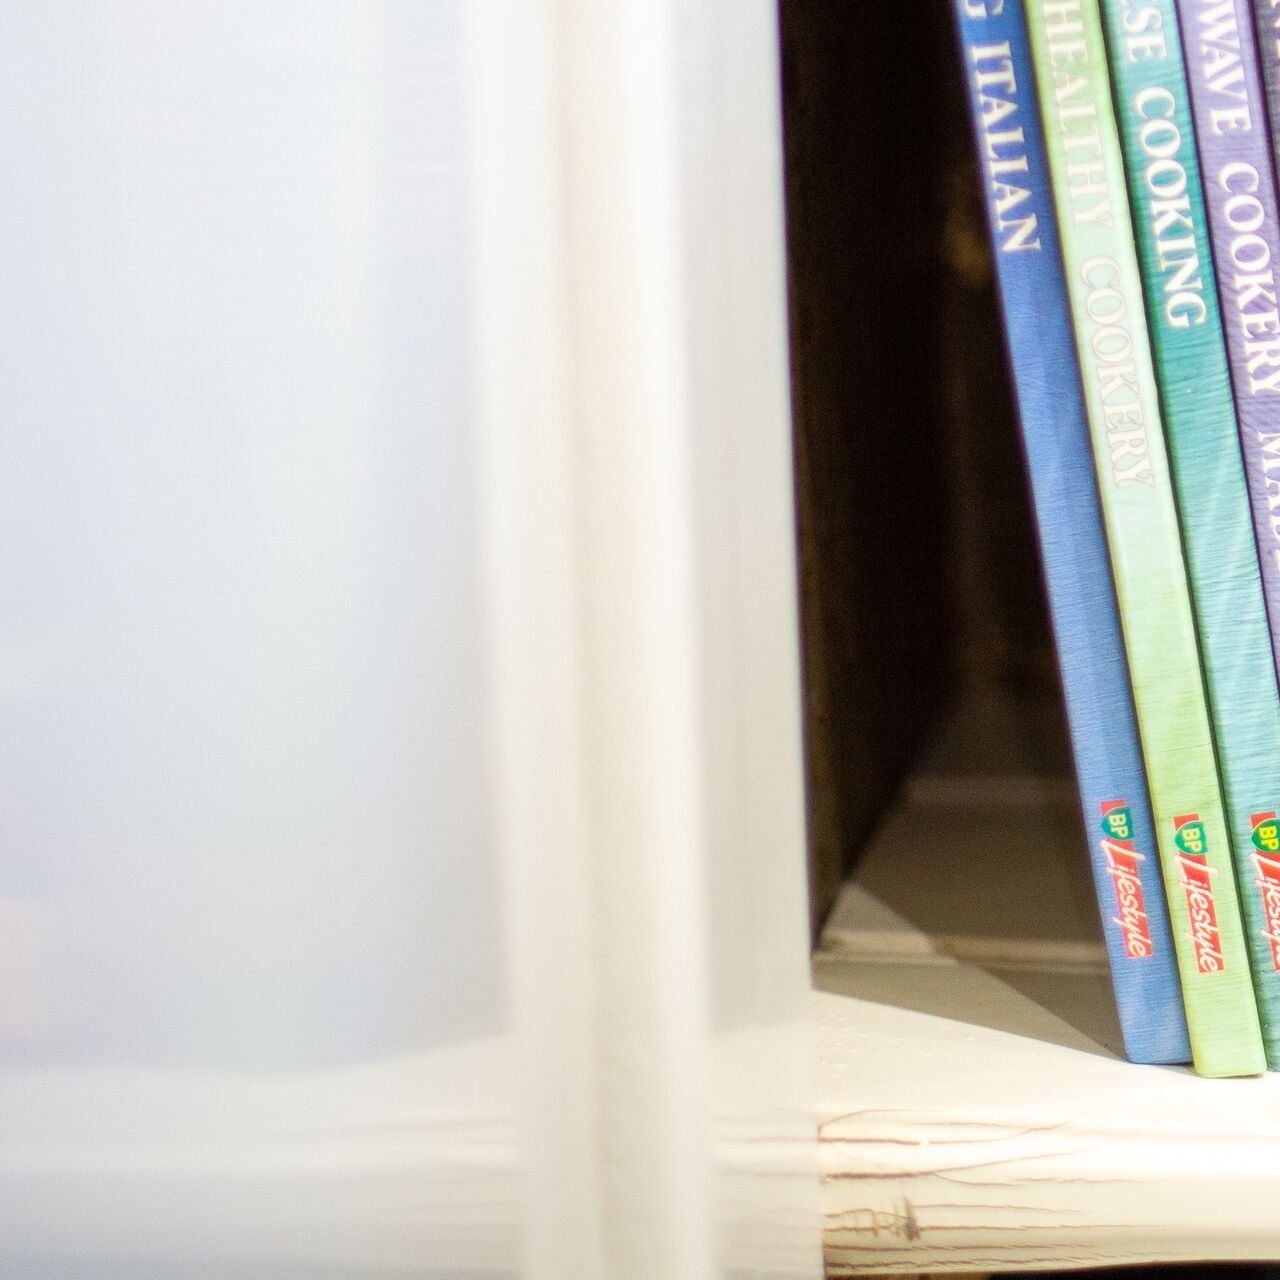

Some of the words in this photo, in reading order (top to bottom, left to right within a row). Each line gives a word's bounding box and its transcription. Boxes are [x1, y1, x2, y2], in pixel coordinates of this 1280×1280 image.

[971, 40, 1042, 253] ITALIAN
[1136, 86, 1207, 329] COOKING
[1080, 255, 1156, 488] COOKERY
[1107, 812, 1128, 838] BP
[1181, 826, 1203, 853] BP
[1257, 824, 1280, 851] BP
[1100, 839, 1152, 958] Lifestyle
[1173, 855, 1219, 972] Lifestyle
